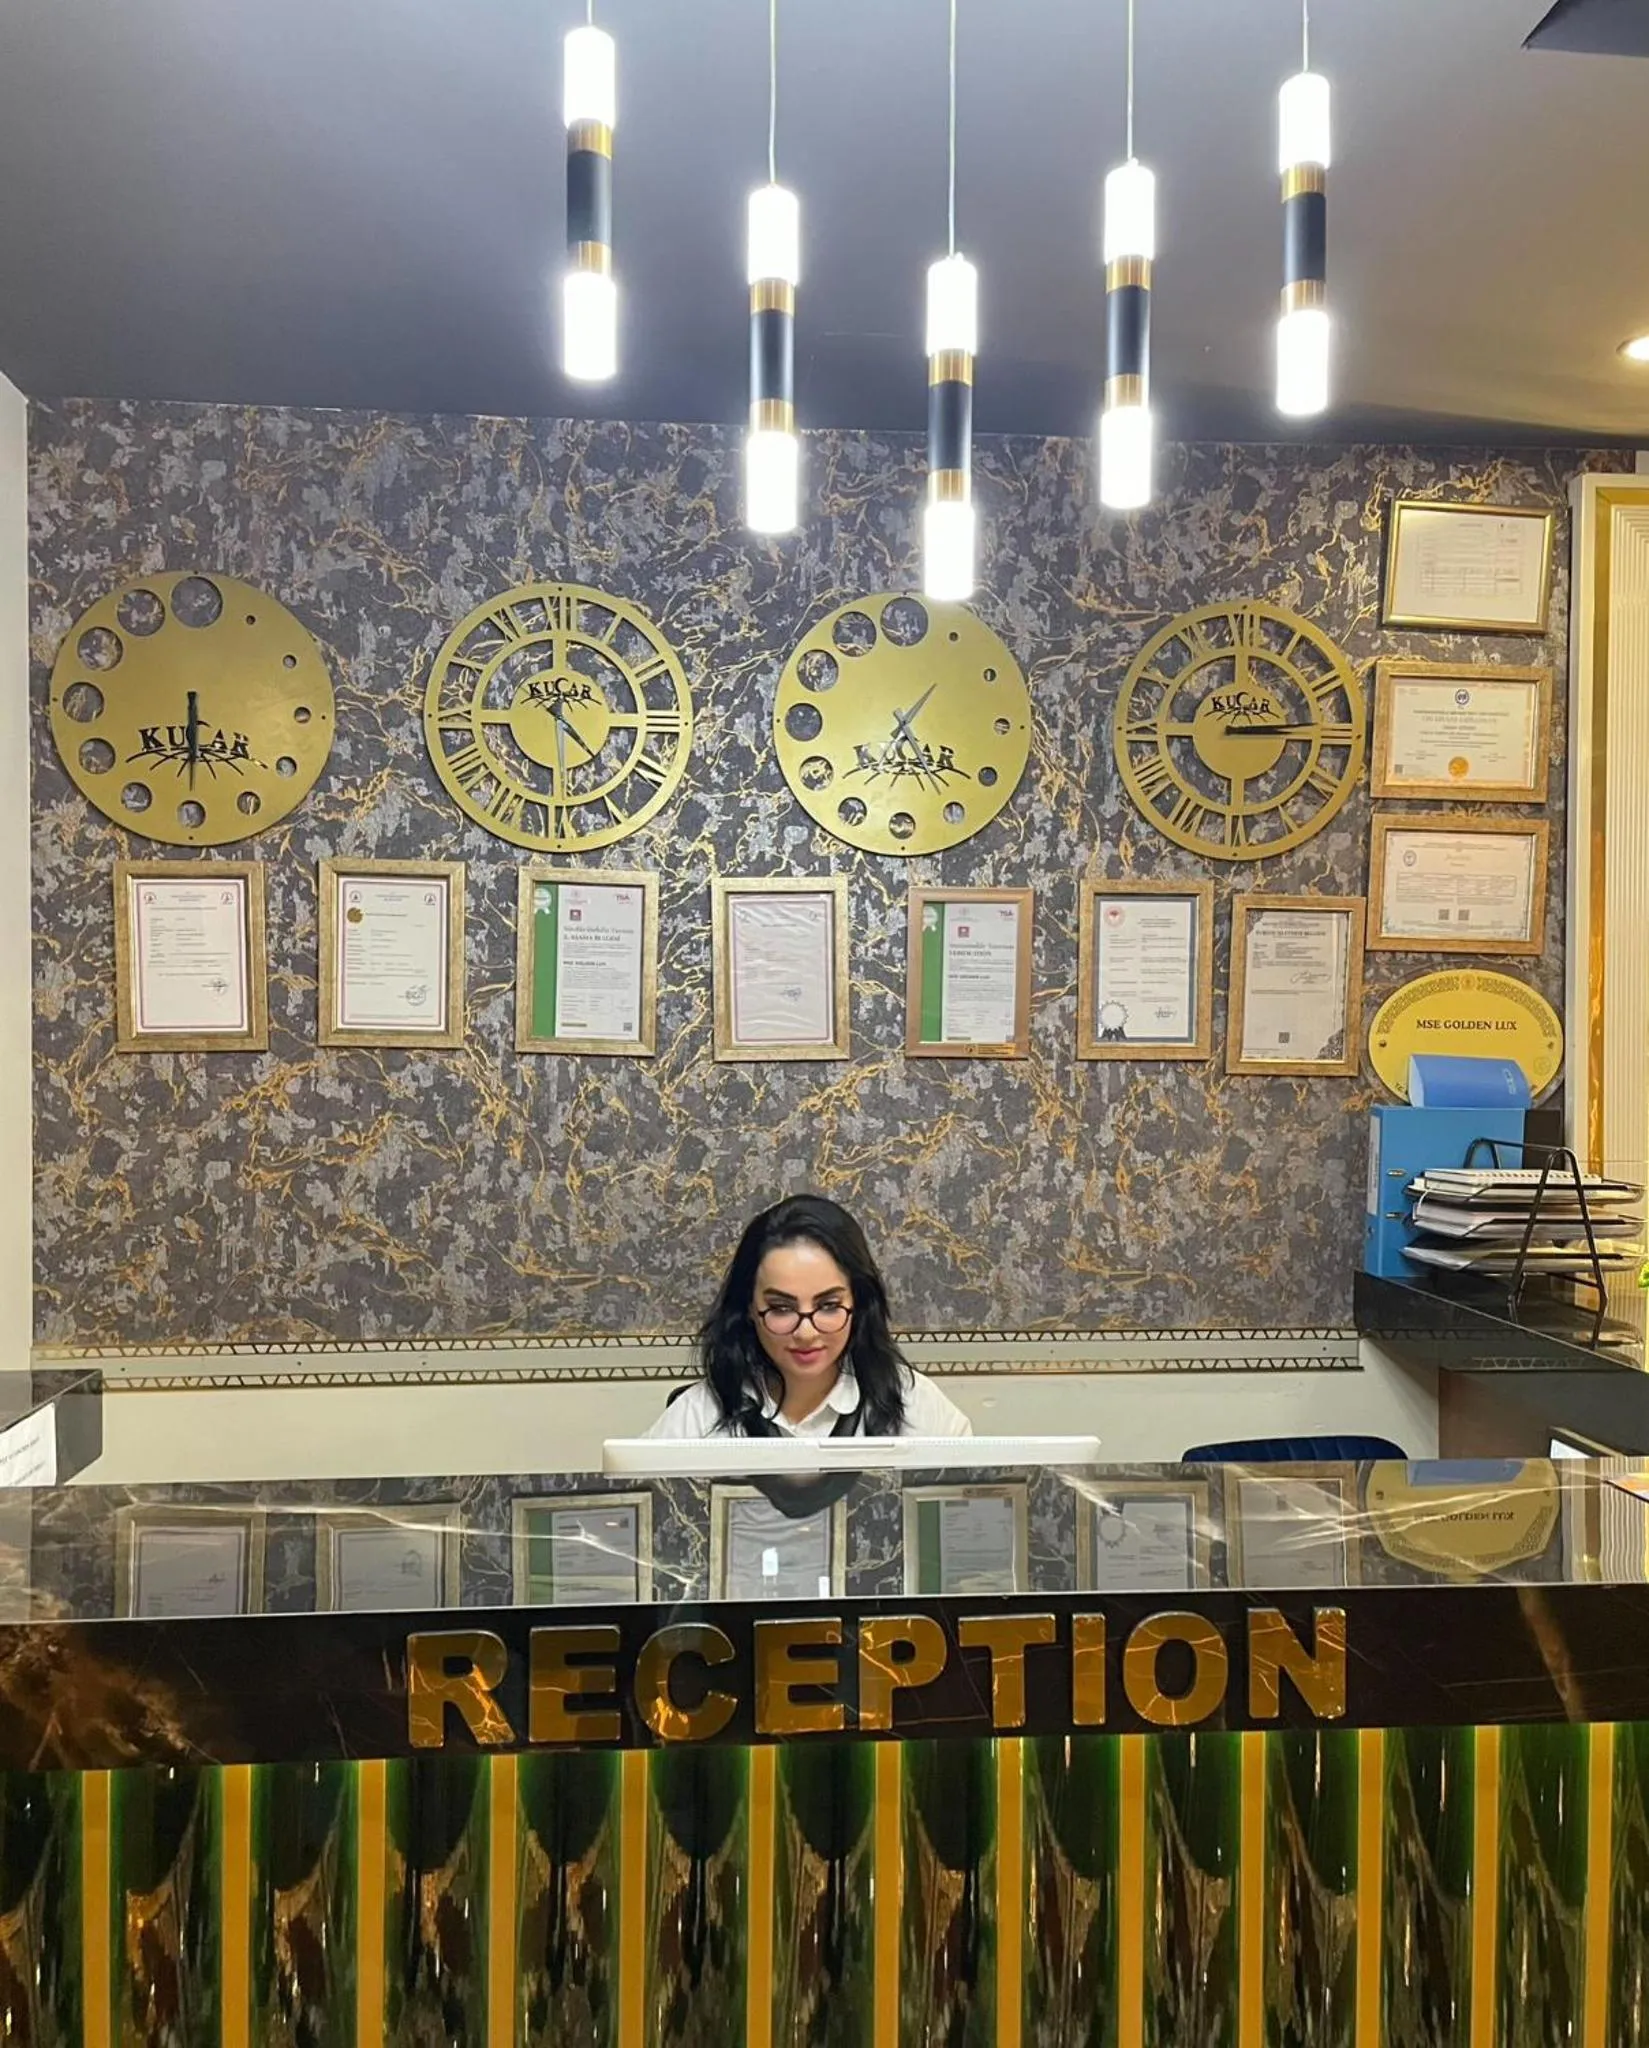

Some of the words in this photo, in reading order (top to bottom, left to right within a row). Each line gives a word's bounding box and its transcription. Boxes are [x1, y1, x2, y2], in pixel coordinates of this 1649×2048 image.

[1416, 1019, 1441, 1029] MSE
[1443, 1020, 1491, 1030] GOLDEN
[1495, 1020, 1517, 1030] LUX
[407, 1607, 1346, 1748] RECEPTION
